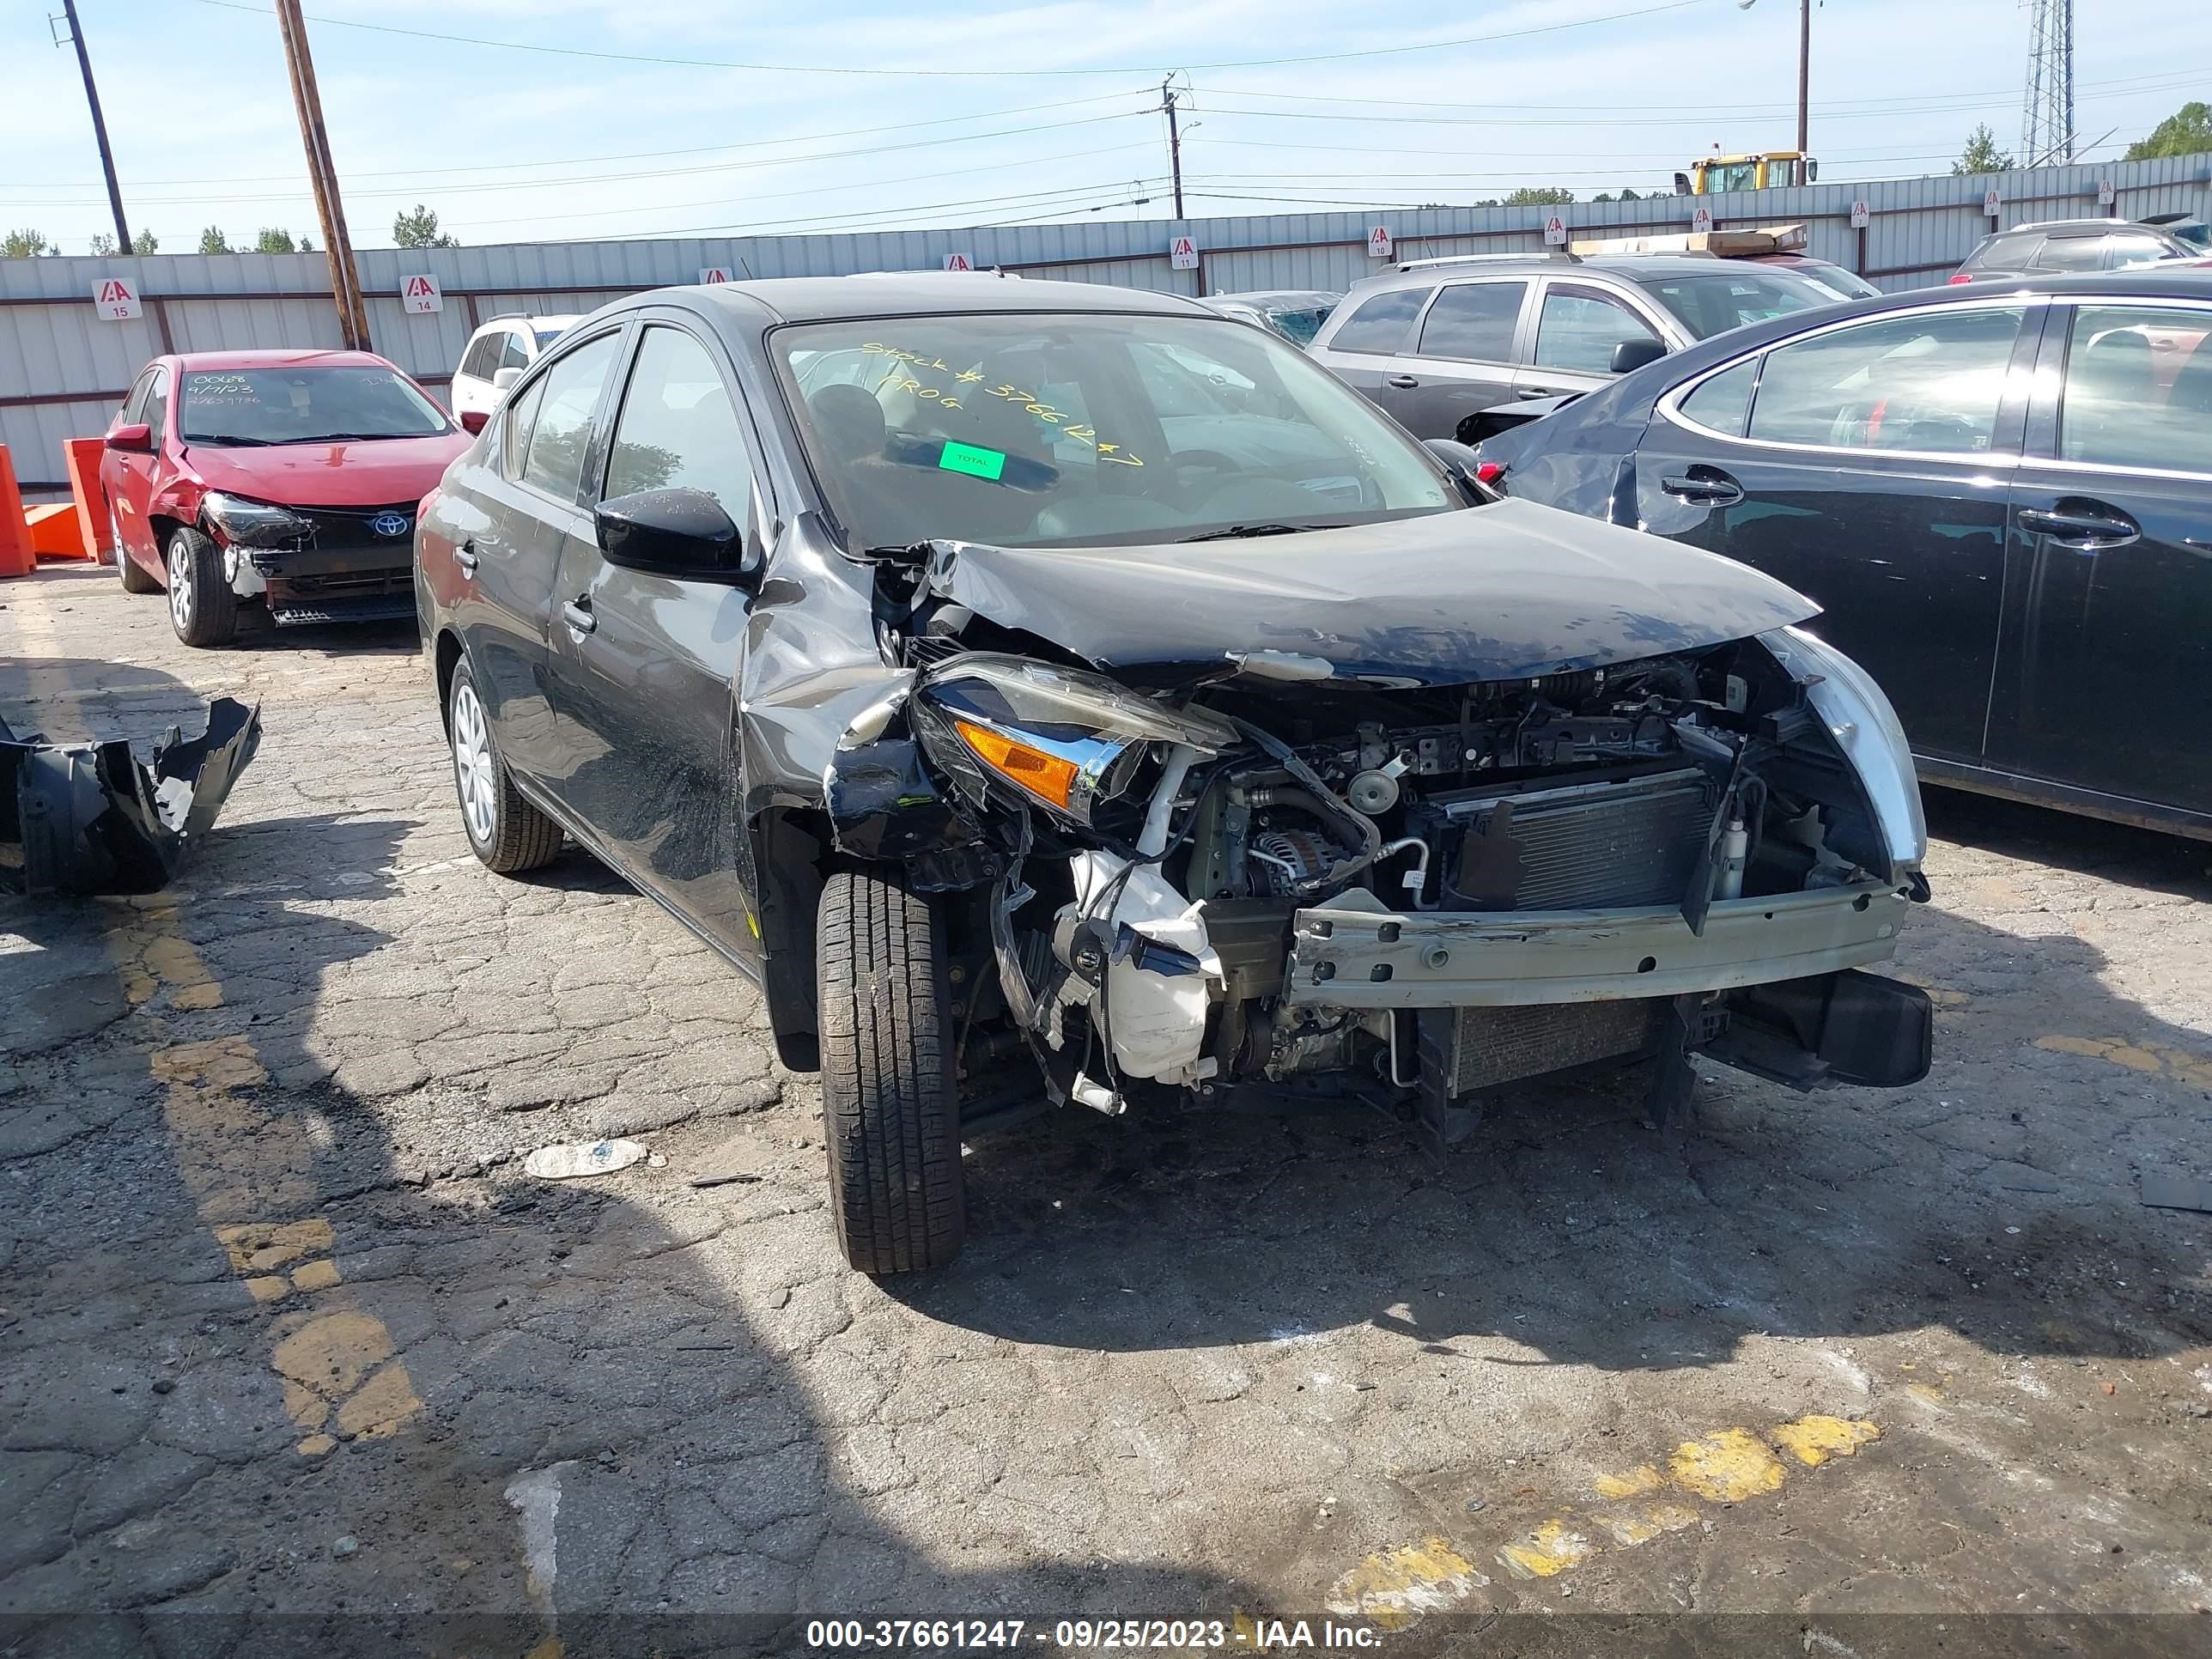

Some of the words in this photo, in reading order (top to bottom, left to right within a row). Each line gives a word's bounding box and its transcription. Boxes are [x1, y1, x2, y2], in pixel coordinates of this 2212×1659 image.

[1376, 246, 1385, 255] 10
[1181, 258, 1190, 268] 11
[417, 301, 431, 311] 14
[113, 307, 128, 317] 15
[957, 454, 989, 466] TOTAL
